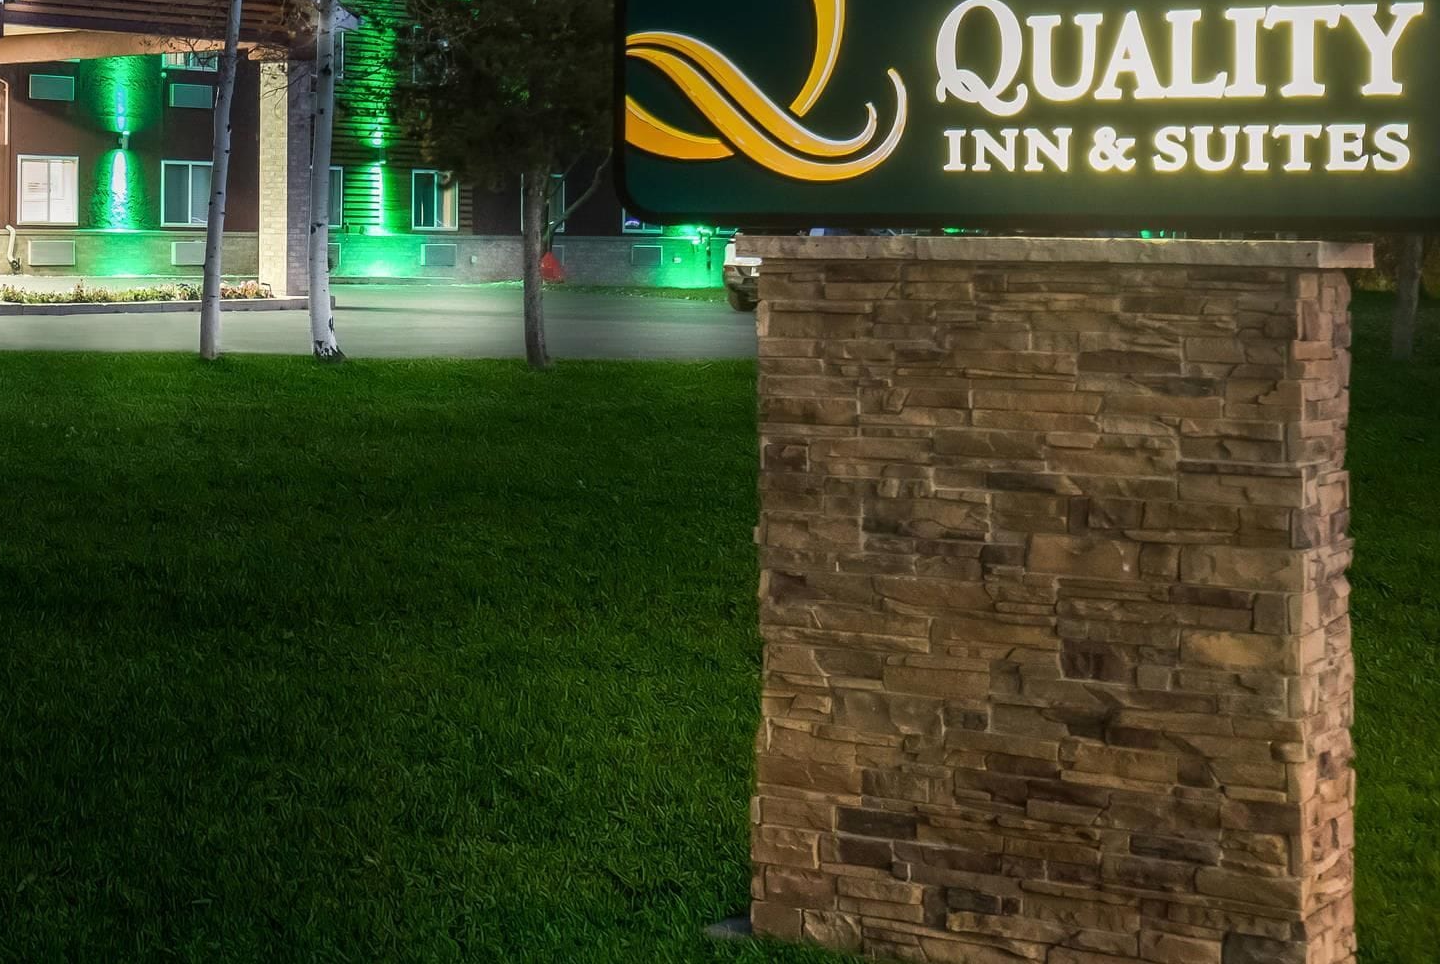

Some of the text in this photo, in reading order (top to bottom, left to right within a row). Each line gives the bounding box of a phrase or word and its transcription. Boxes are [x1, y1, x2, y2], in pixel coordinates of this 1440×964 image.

[943, 123, 1411, 173] INN & SUITES
